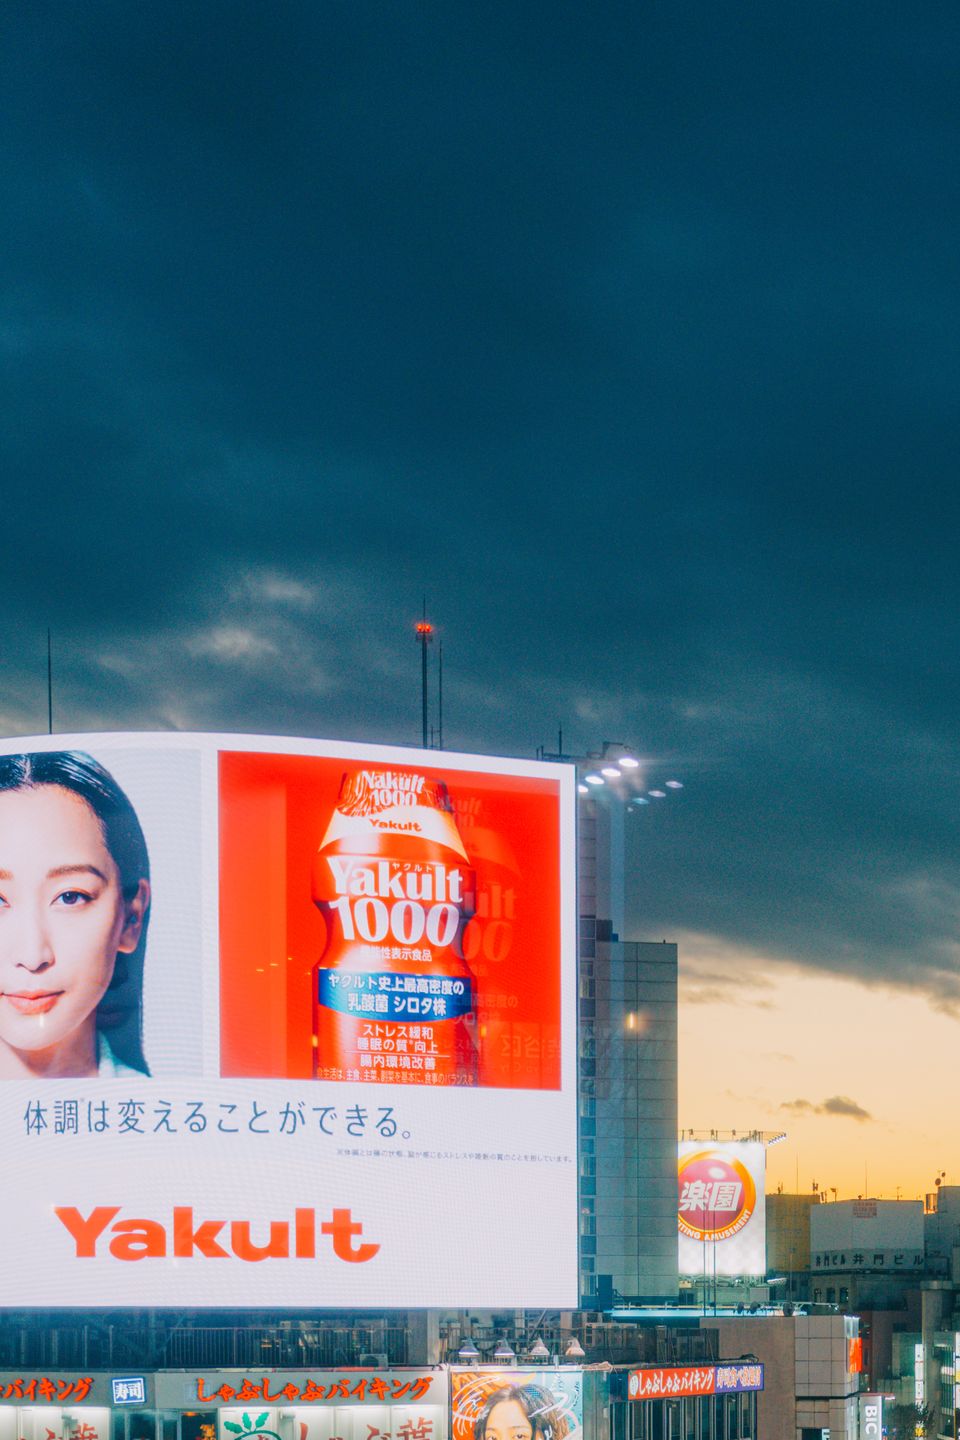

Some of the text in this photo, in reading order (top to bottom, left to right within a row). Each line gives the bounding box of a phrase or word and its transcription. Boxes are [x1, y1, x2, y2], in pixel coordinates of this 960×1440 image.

[369, 818, 422, 832] Yakult
[326, 857, 463, 903] Yakult
[392, 863, 434, 872] ヤクルト
[329, 896, 460, 947] 1000
[328, 974, 465, 996] ヤクルト史上最高密度の
[347, 993, 447, 1016] 乳酸菌 シロタ株
[363, 1024, 434, 1040] ストレス緩和
[360, 1054, 436, 1070] 腸内環境改善
[24, 1098, 413, 1140] 体調は変えることができる。
[679, 1180, 742, 1212] 楽園
[54, 1205, 381, 1262] Yakult
[704, 1209, 751, 1241] AMUSEMENT
[114, 1382, 143, 1400] 寿司
[197, 1376, 433, 1402] しゃぶしゃぶバイキング
[864, 1405, 878, 1434] BIC
